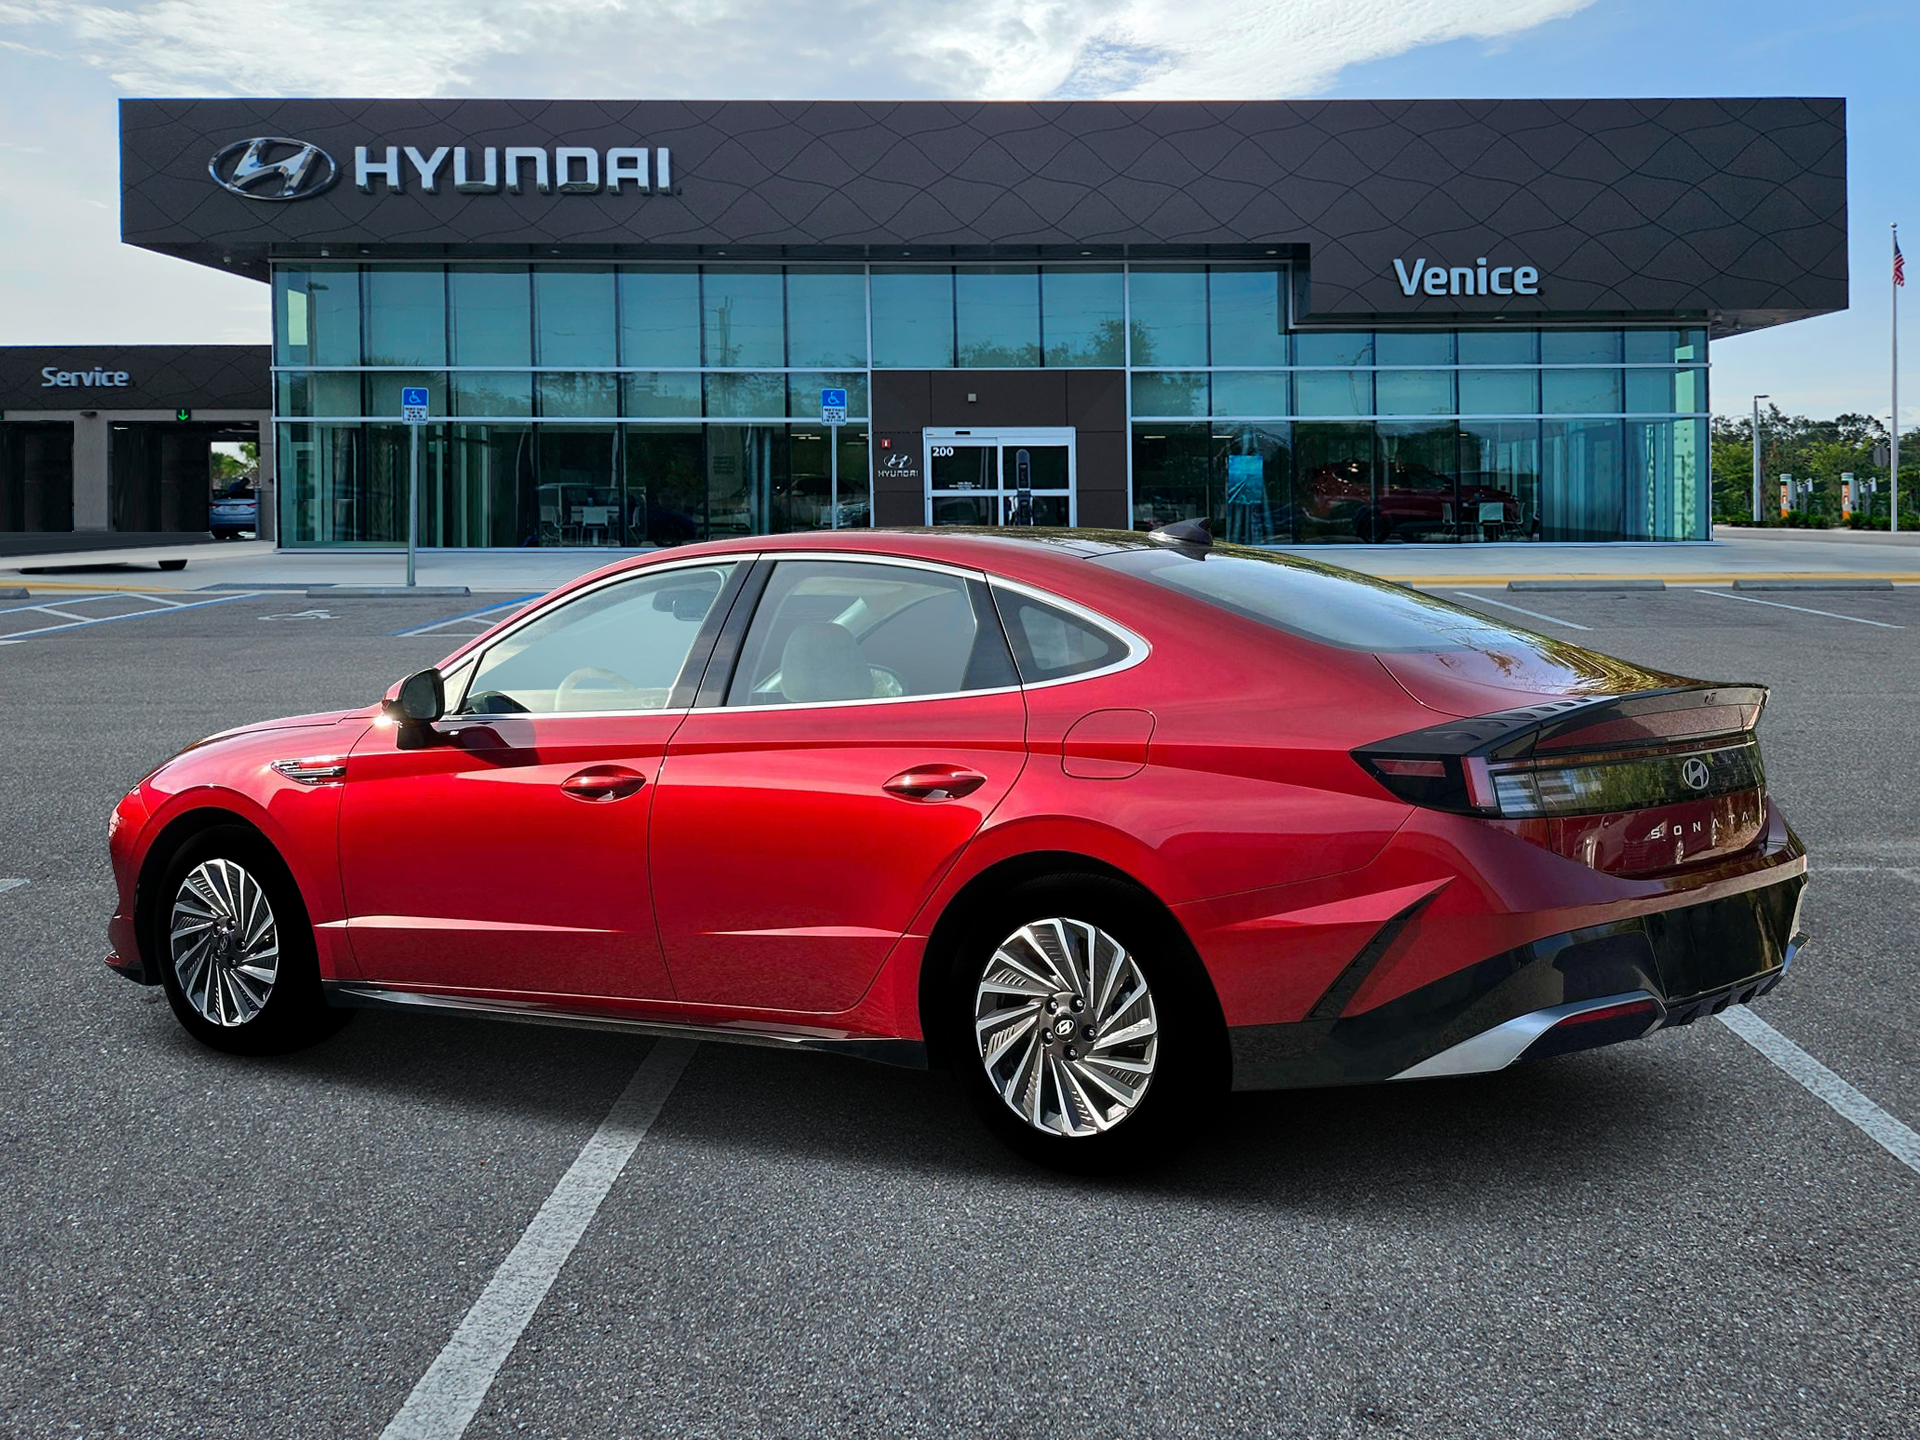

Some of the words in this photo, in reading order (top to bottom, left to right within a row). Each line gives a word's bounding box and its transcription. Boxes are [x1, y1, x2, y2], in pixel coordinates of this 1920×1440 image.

[355, 146, 671, 195] HYUNDAI
[1392, 257, 1539, 296] Venice
[41, 366, 130, 387] Service
[932, 447, 954, 457] 200
[877, 469, 919, 478] HYUNDAI
[1650, 811, 1749, 839] SONATA
